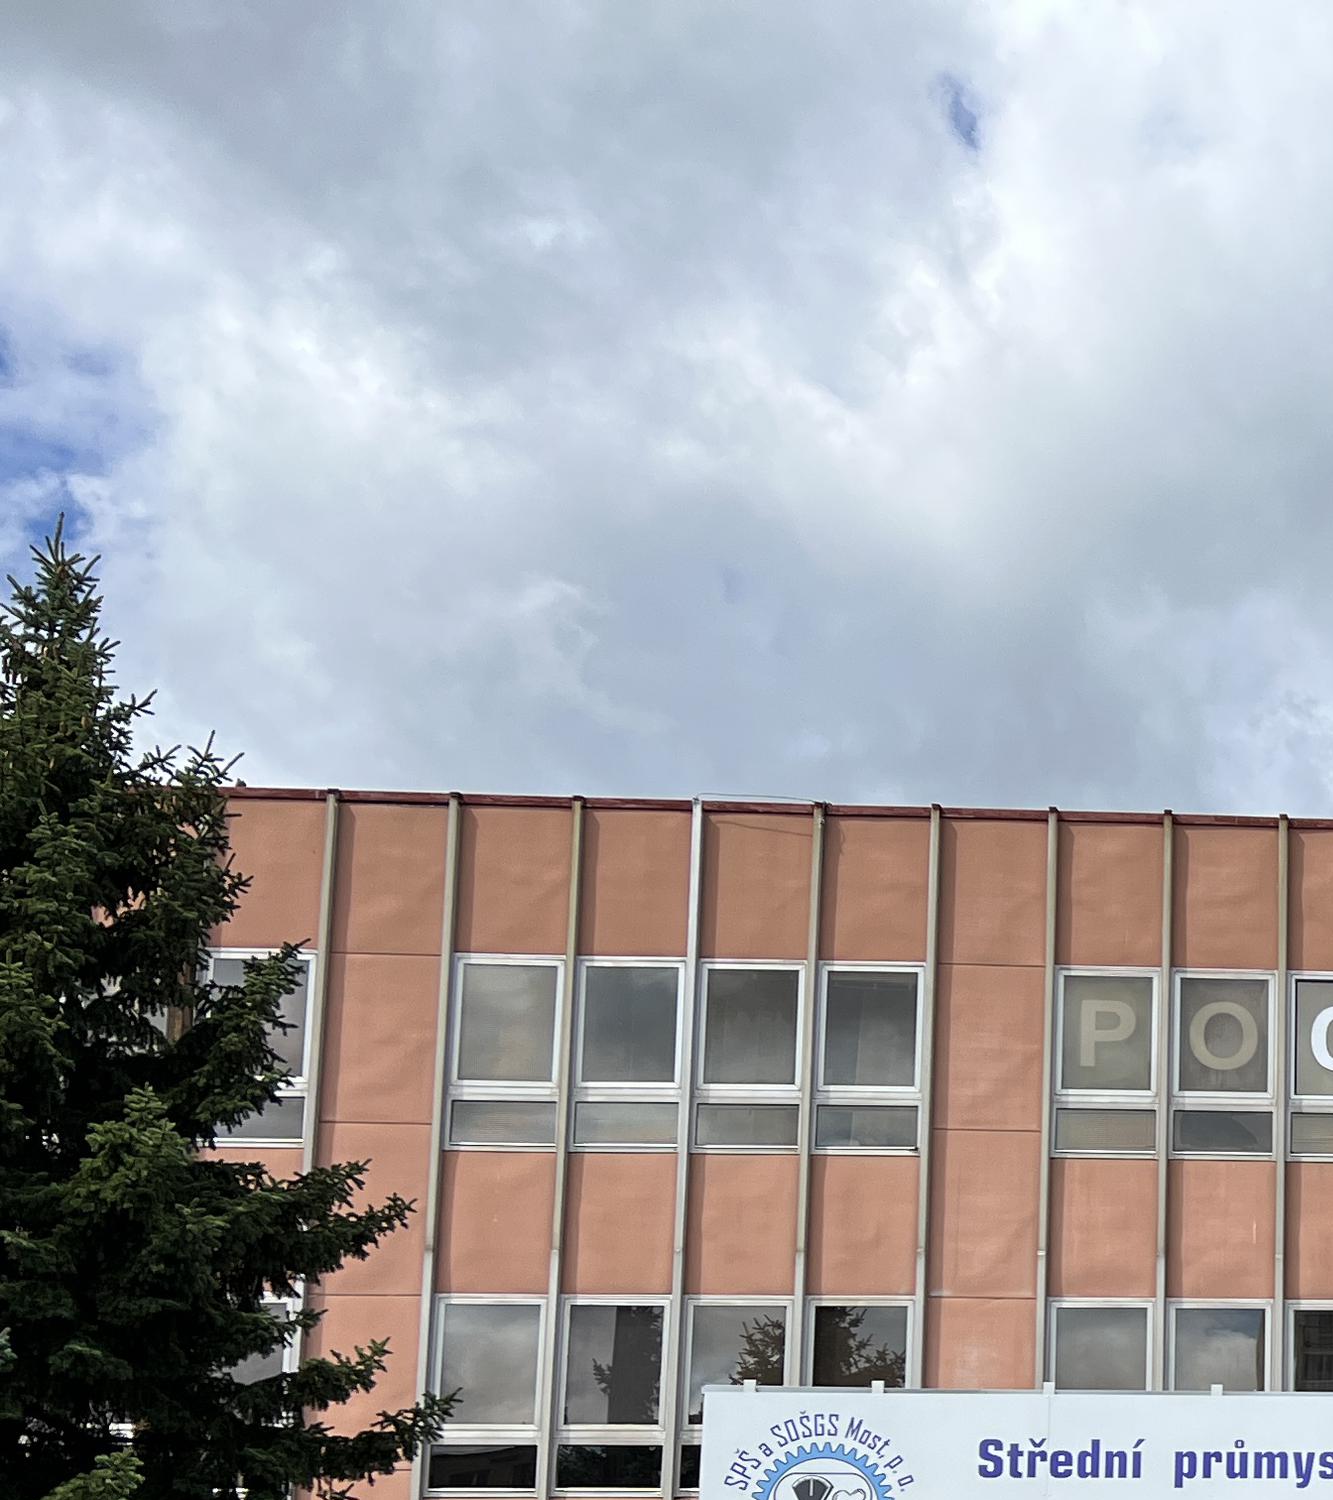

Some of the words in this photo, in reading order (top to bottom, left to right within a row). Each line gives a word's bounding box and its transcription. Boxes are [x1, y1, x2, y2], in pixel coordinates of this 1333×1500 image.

[724, 1448, 762, 1491] SPŠ
[758, 1443, 774, 1457] a
[770, 1411, 839, 1447] SOŠGS
[845, 1416, 890, 1459] Most,
[978, 1438, 1146, 1479] Střední
